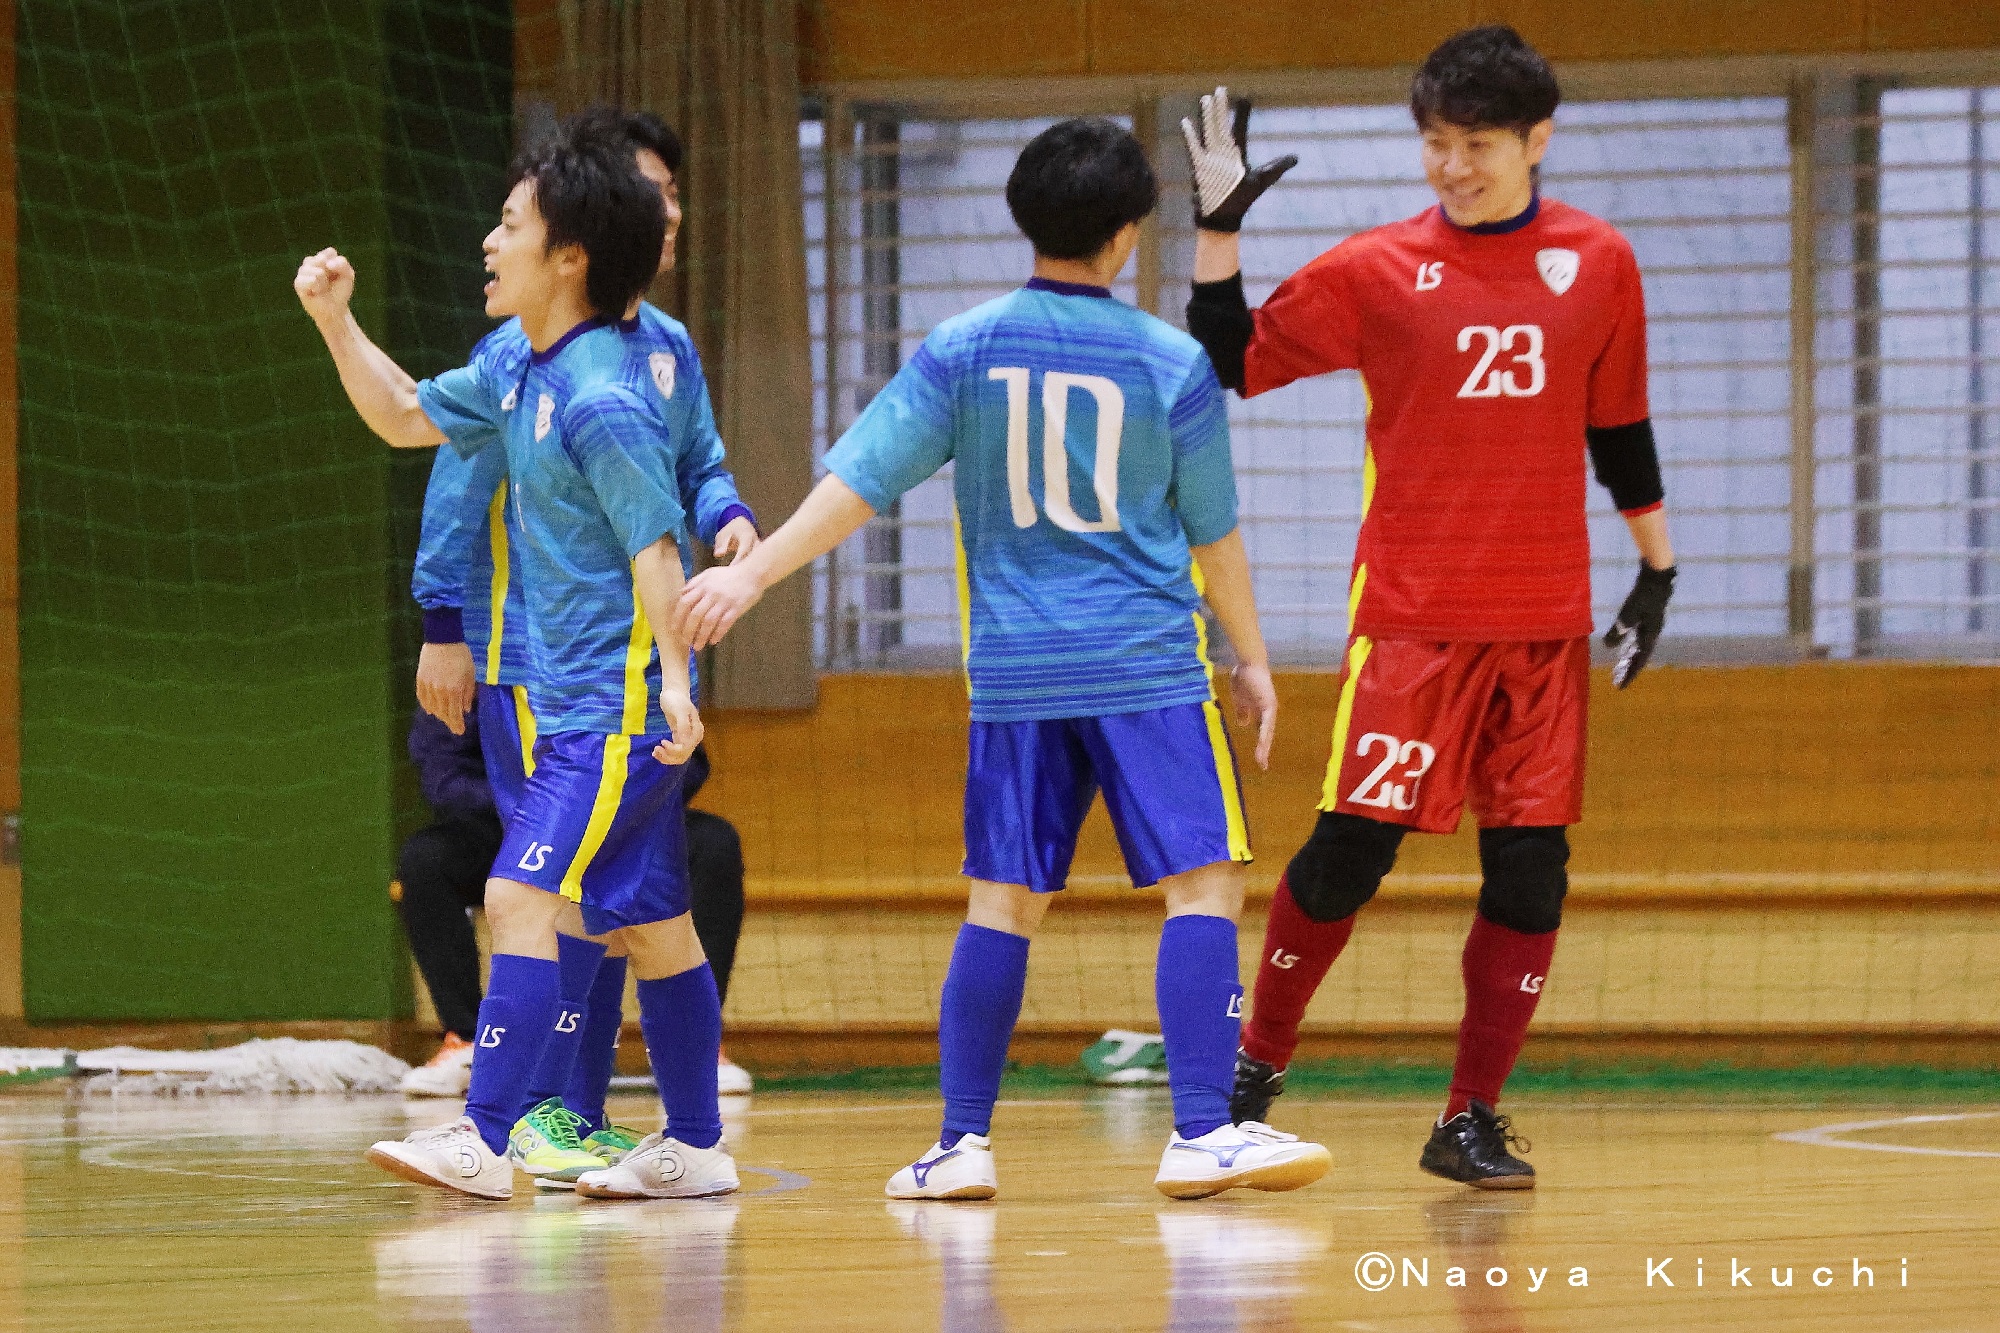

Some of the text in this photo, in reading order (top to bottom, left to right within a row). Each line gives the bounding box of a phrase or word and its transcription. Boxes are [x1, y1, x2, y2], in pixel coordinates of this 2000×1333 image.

[1415, 261, 1444, 292] LS
[1456, 323, 1546, 398] 23
[987, 366, 1126, 533] 10
[1346, 731, 1436, 811] 23
[517, 841, 554, 872] LS
[478, 1024, 506, 1049] LS
[555, 1010, 581, 1034] LS
